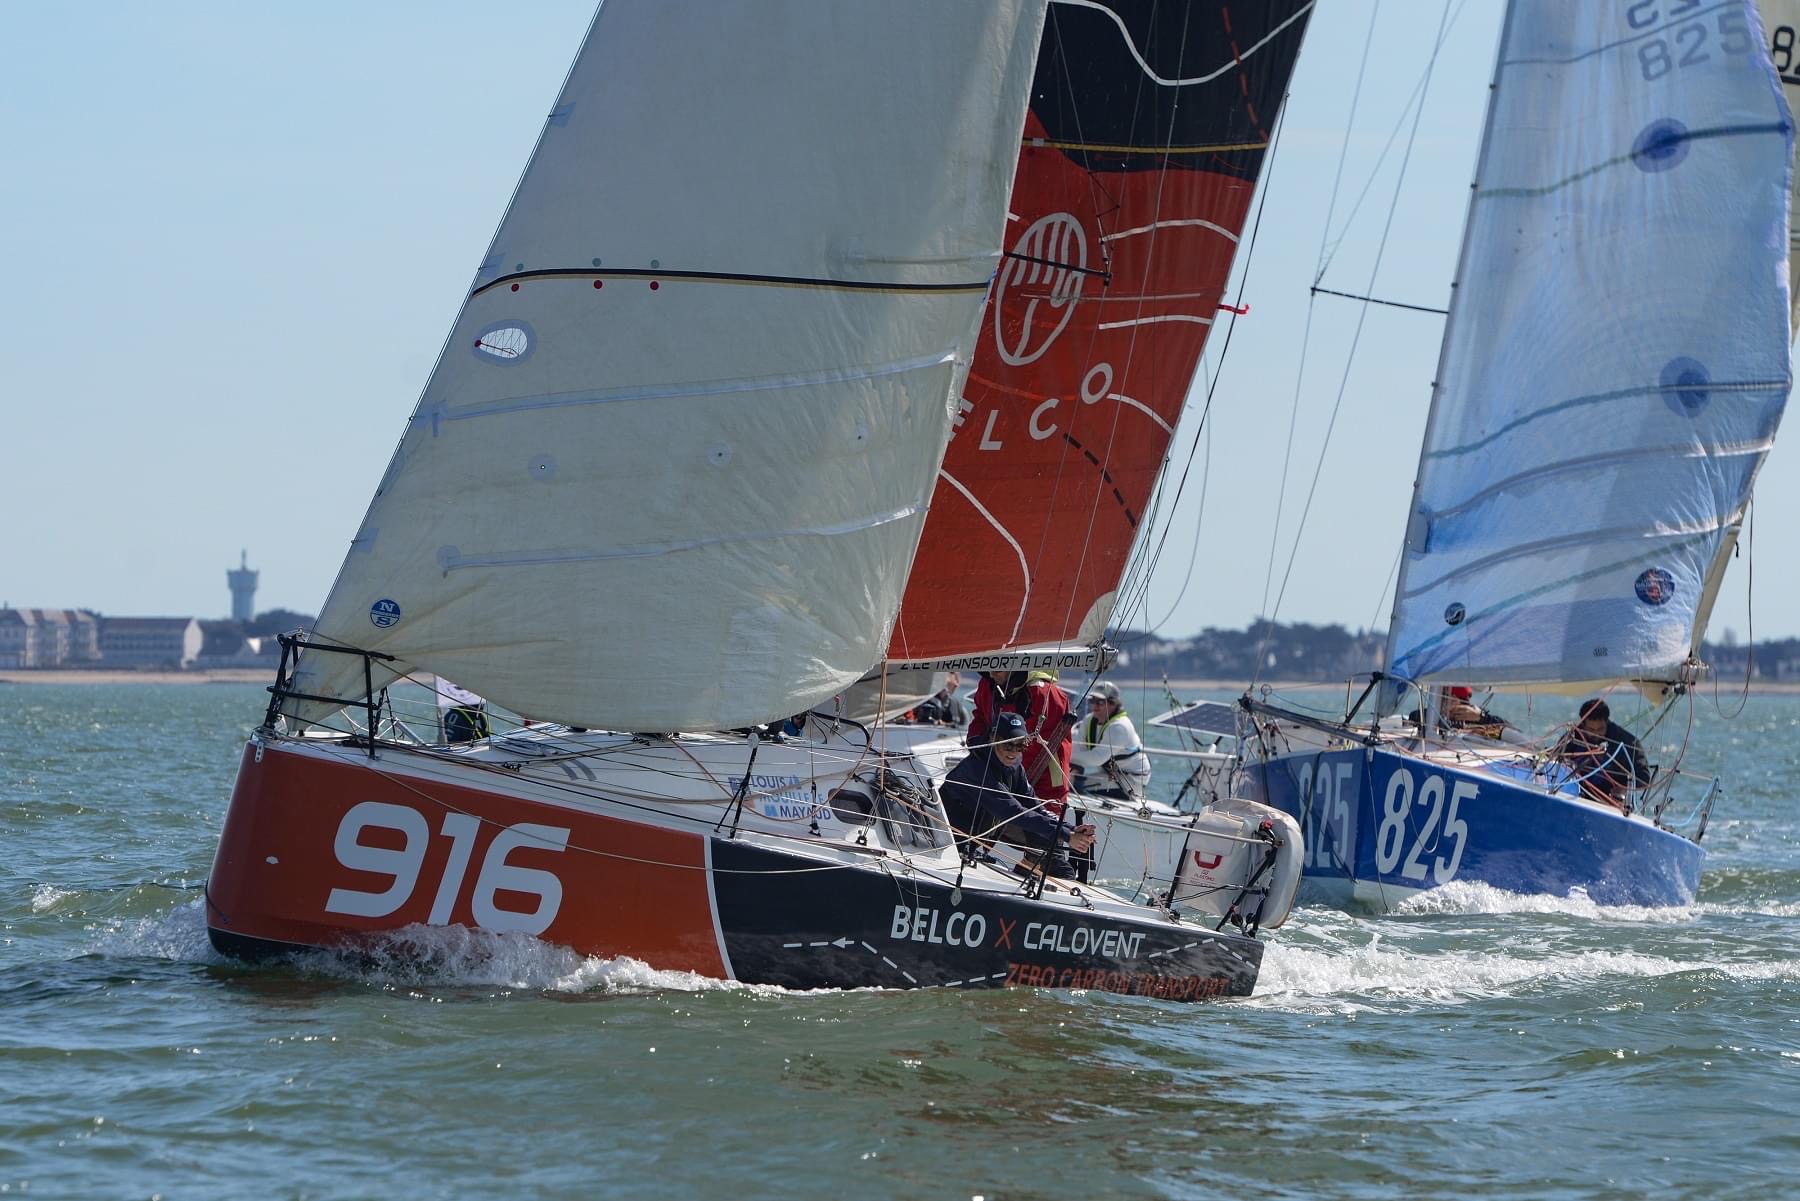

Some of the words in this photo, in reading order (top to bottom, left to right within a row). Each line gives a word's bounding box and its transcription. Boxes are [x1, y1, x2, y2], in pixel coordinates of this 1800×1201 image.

[1638, 11, 1752, 82] 825
[1772, 26, 1800, 75] 8
[936, 656, 1018, 670] TRANSPORT
[1020, 653, 1031, 666] À
[1033, 655, 1050, 667] LA
[752, 775, 786, 789] LOUIS
[1300, 762, 1353, 869] 825
[1376, 768, 1479, 885] 825
[324, 800, 571, 937] 916
[890, 904, 987, 949] BELCO
[994, 918, 1017, 950] X
[1023, 922, 1147, 959] CALOVENT
[1003, 963, 1056, 989] ZERO
[1059, 968, 1130, 995] CARBON
[1135, 971, 1230, 1000] TRANSPORT
